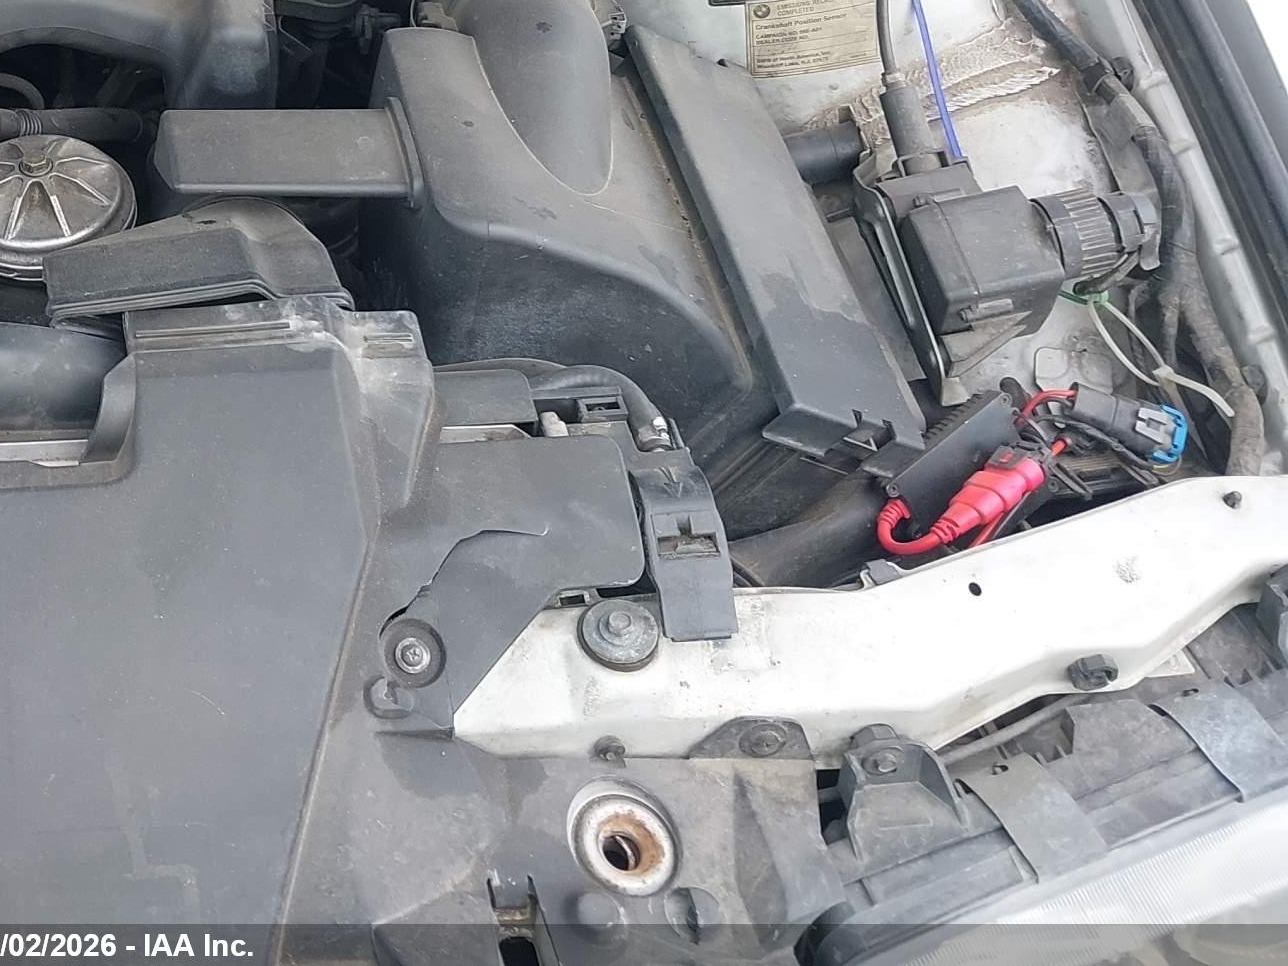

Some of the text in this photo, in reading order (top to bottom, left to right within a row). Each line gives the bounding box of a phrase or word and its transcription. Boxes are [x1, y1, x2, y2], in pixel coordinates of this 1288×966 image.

[777, 7, 815, 17] COMPLETED
[755, 13, 848, 31] Crankshaft Position Sensor
